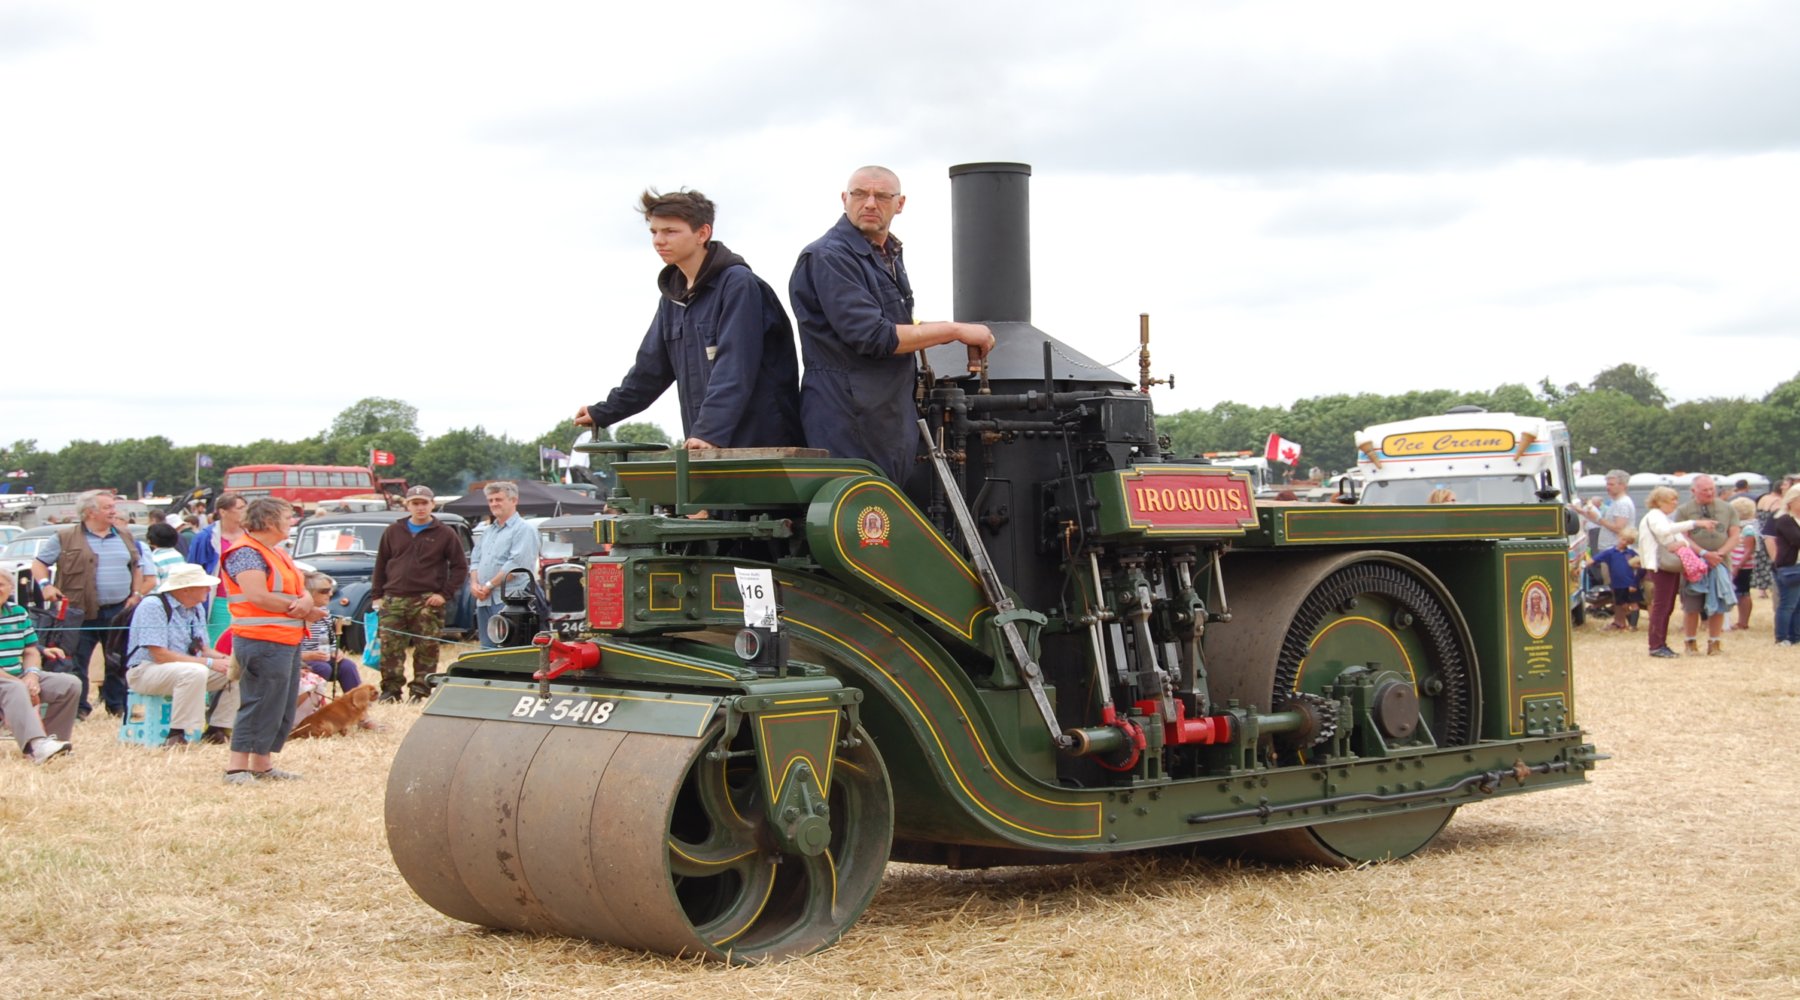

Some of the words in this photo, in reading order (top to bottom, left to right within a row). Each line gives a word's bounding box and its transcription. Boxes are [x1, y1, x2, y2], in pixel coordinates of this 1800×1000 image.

[1393, 437, 1424, 452] Ice
[1433, 434, 1504, 451] Cream
[1136, 488, 1248, 512] IROQUOIS.
[512, 696, 549, 718] BF
[550, 699, 614, 724] 5418
